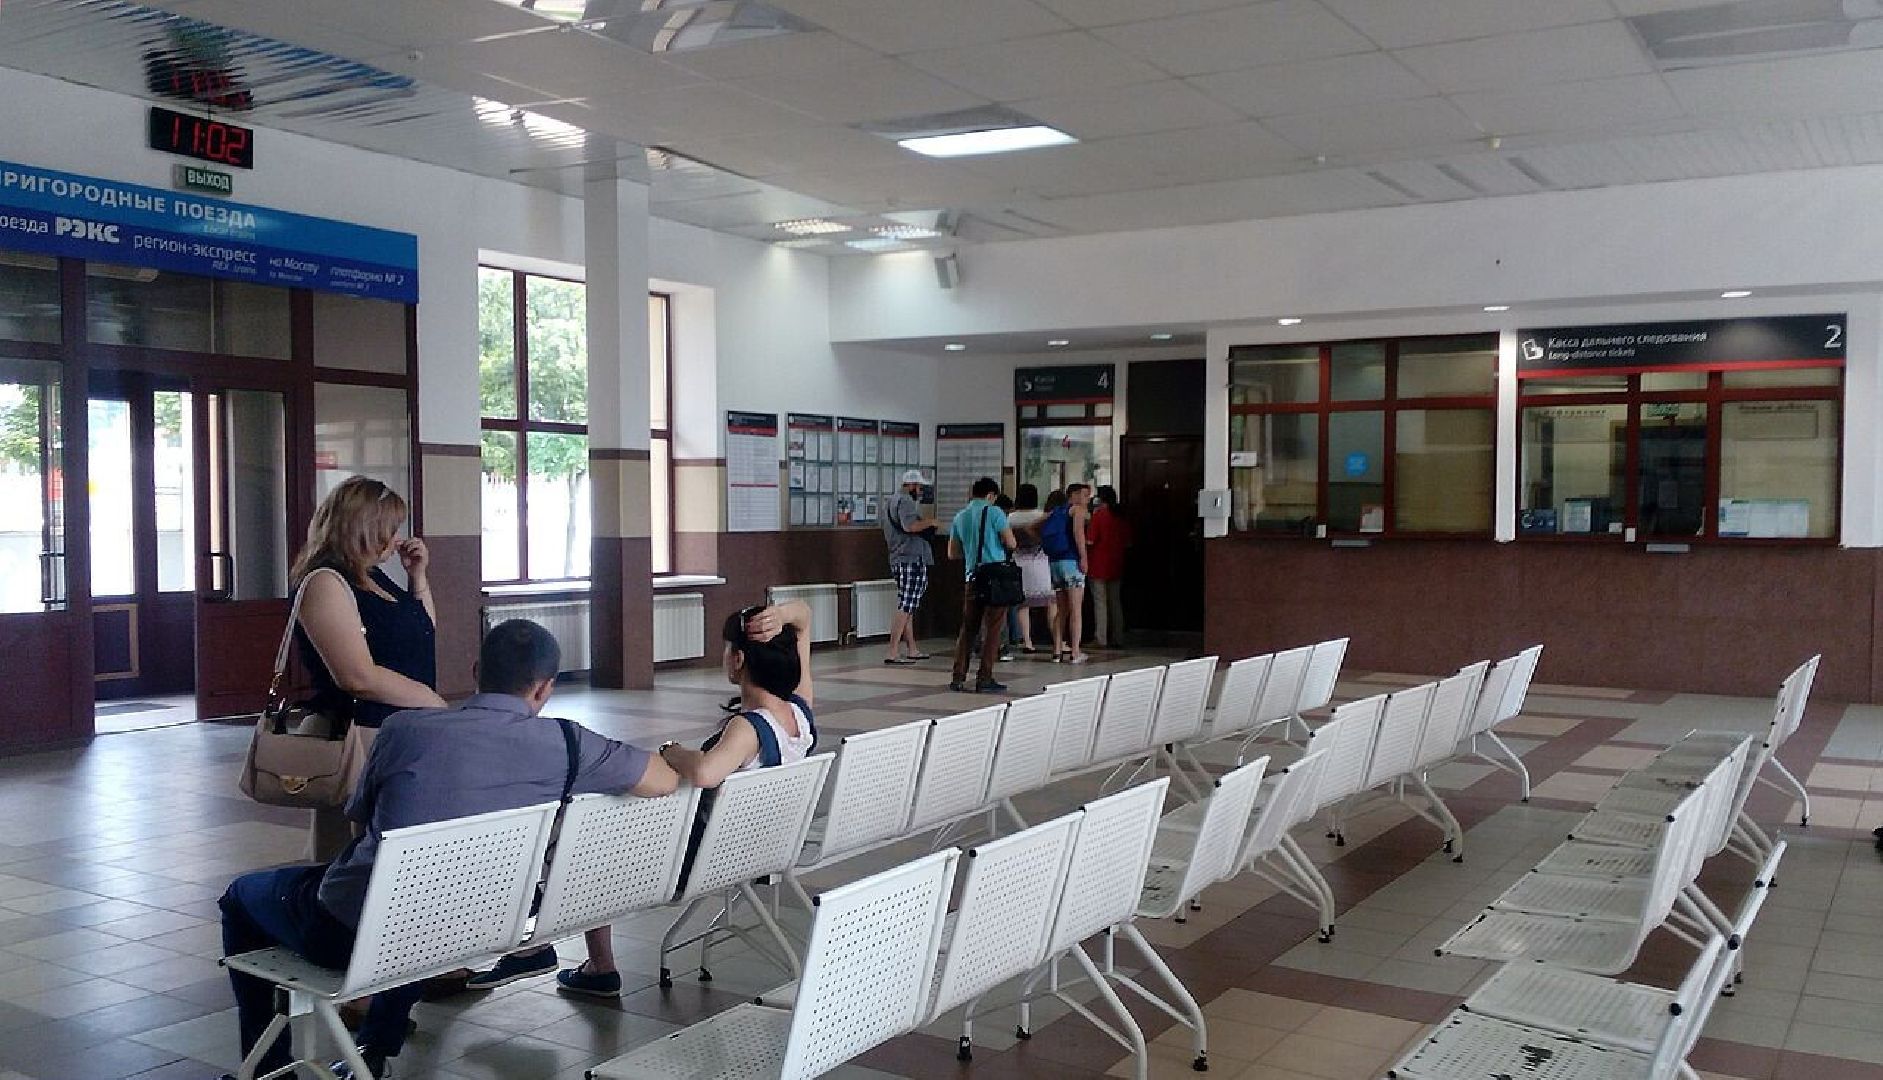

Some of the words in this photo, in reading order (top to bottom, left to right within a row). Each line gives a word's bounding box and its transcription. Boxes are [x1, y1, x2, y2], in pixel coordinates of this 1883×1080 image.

[172, 116, 246, 165] 11:02
[187, 169, 230, 190] ВЫХОД
[0, 169, 166, 214] РИГОРОДНЫЕ
[174, 200, 256, 229] ПОЕЗДА
[55, 216, 120, 243] РЭКС
[134, 235, 257, 264] регион-экспресс
[1548, 337, 1579, 349] Касса
[1581, 335, 1635, 348] дальнего
[1636, 331, 1708, 346] следования
[1824, 324, 1842, 349] 2
[1097, 371, 1109, 389] 4
